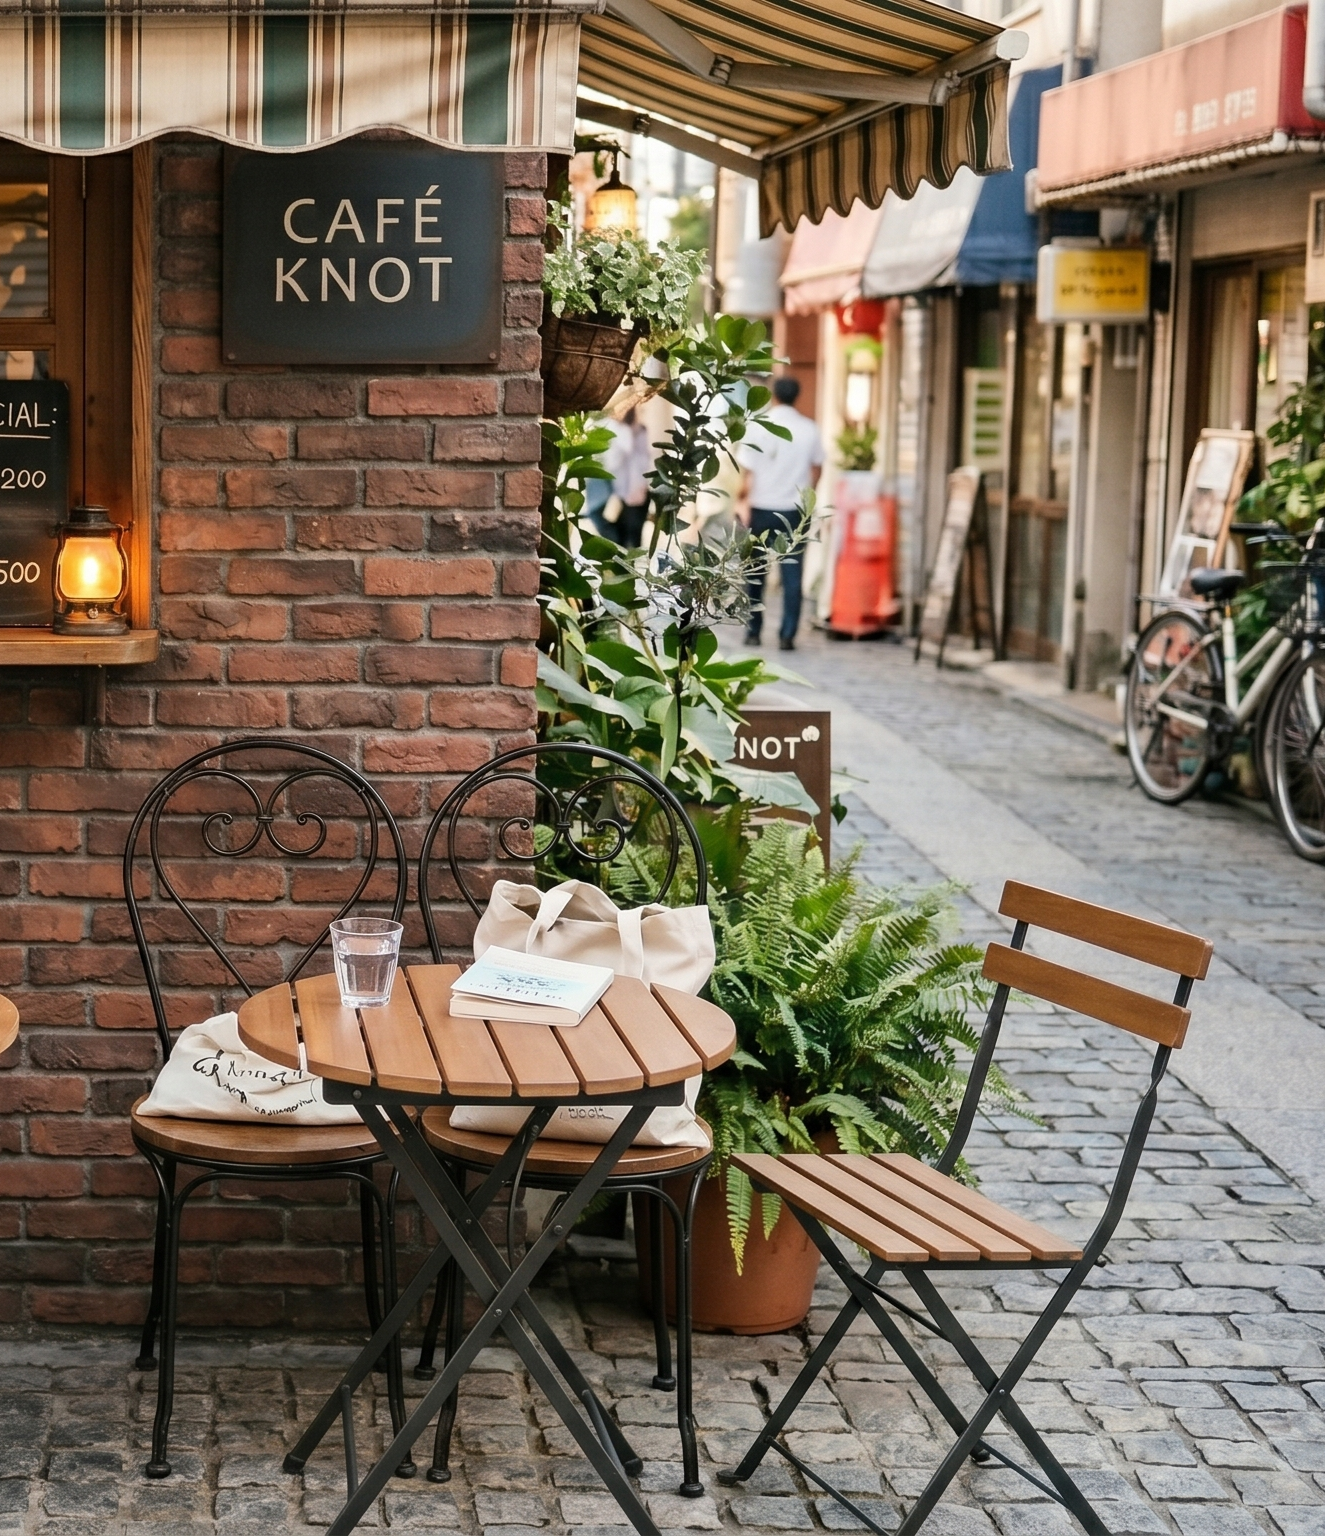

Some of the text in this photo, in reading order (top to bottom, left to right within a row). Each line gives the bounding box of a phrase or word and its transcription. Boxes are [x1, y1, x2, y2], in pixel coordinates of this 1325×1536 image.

[283, 184, 443, 244] CAFÉ
[275, 256, 453, 303] KNOT
[736, 736, 801, 760] NOT
